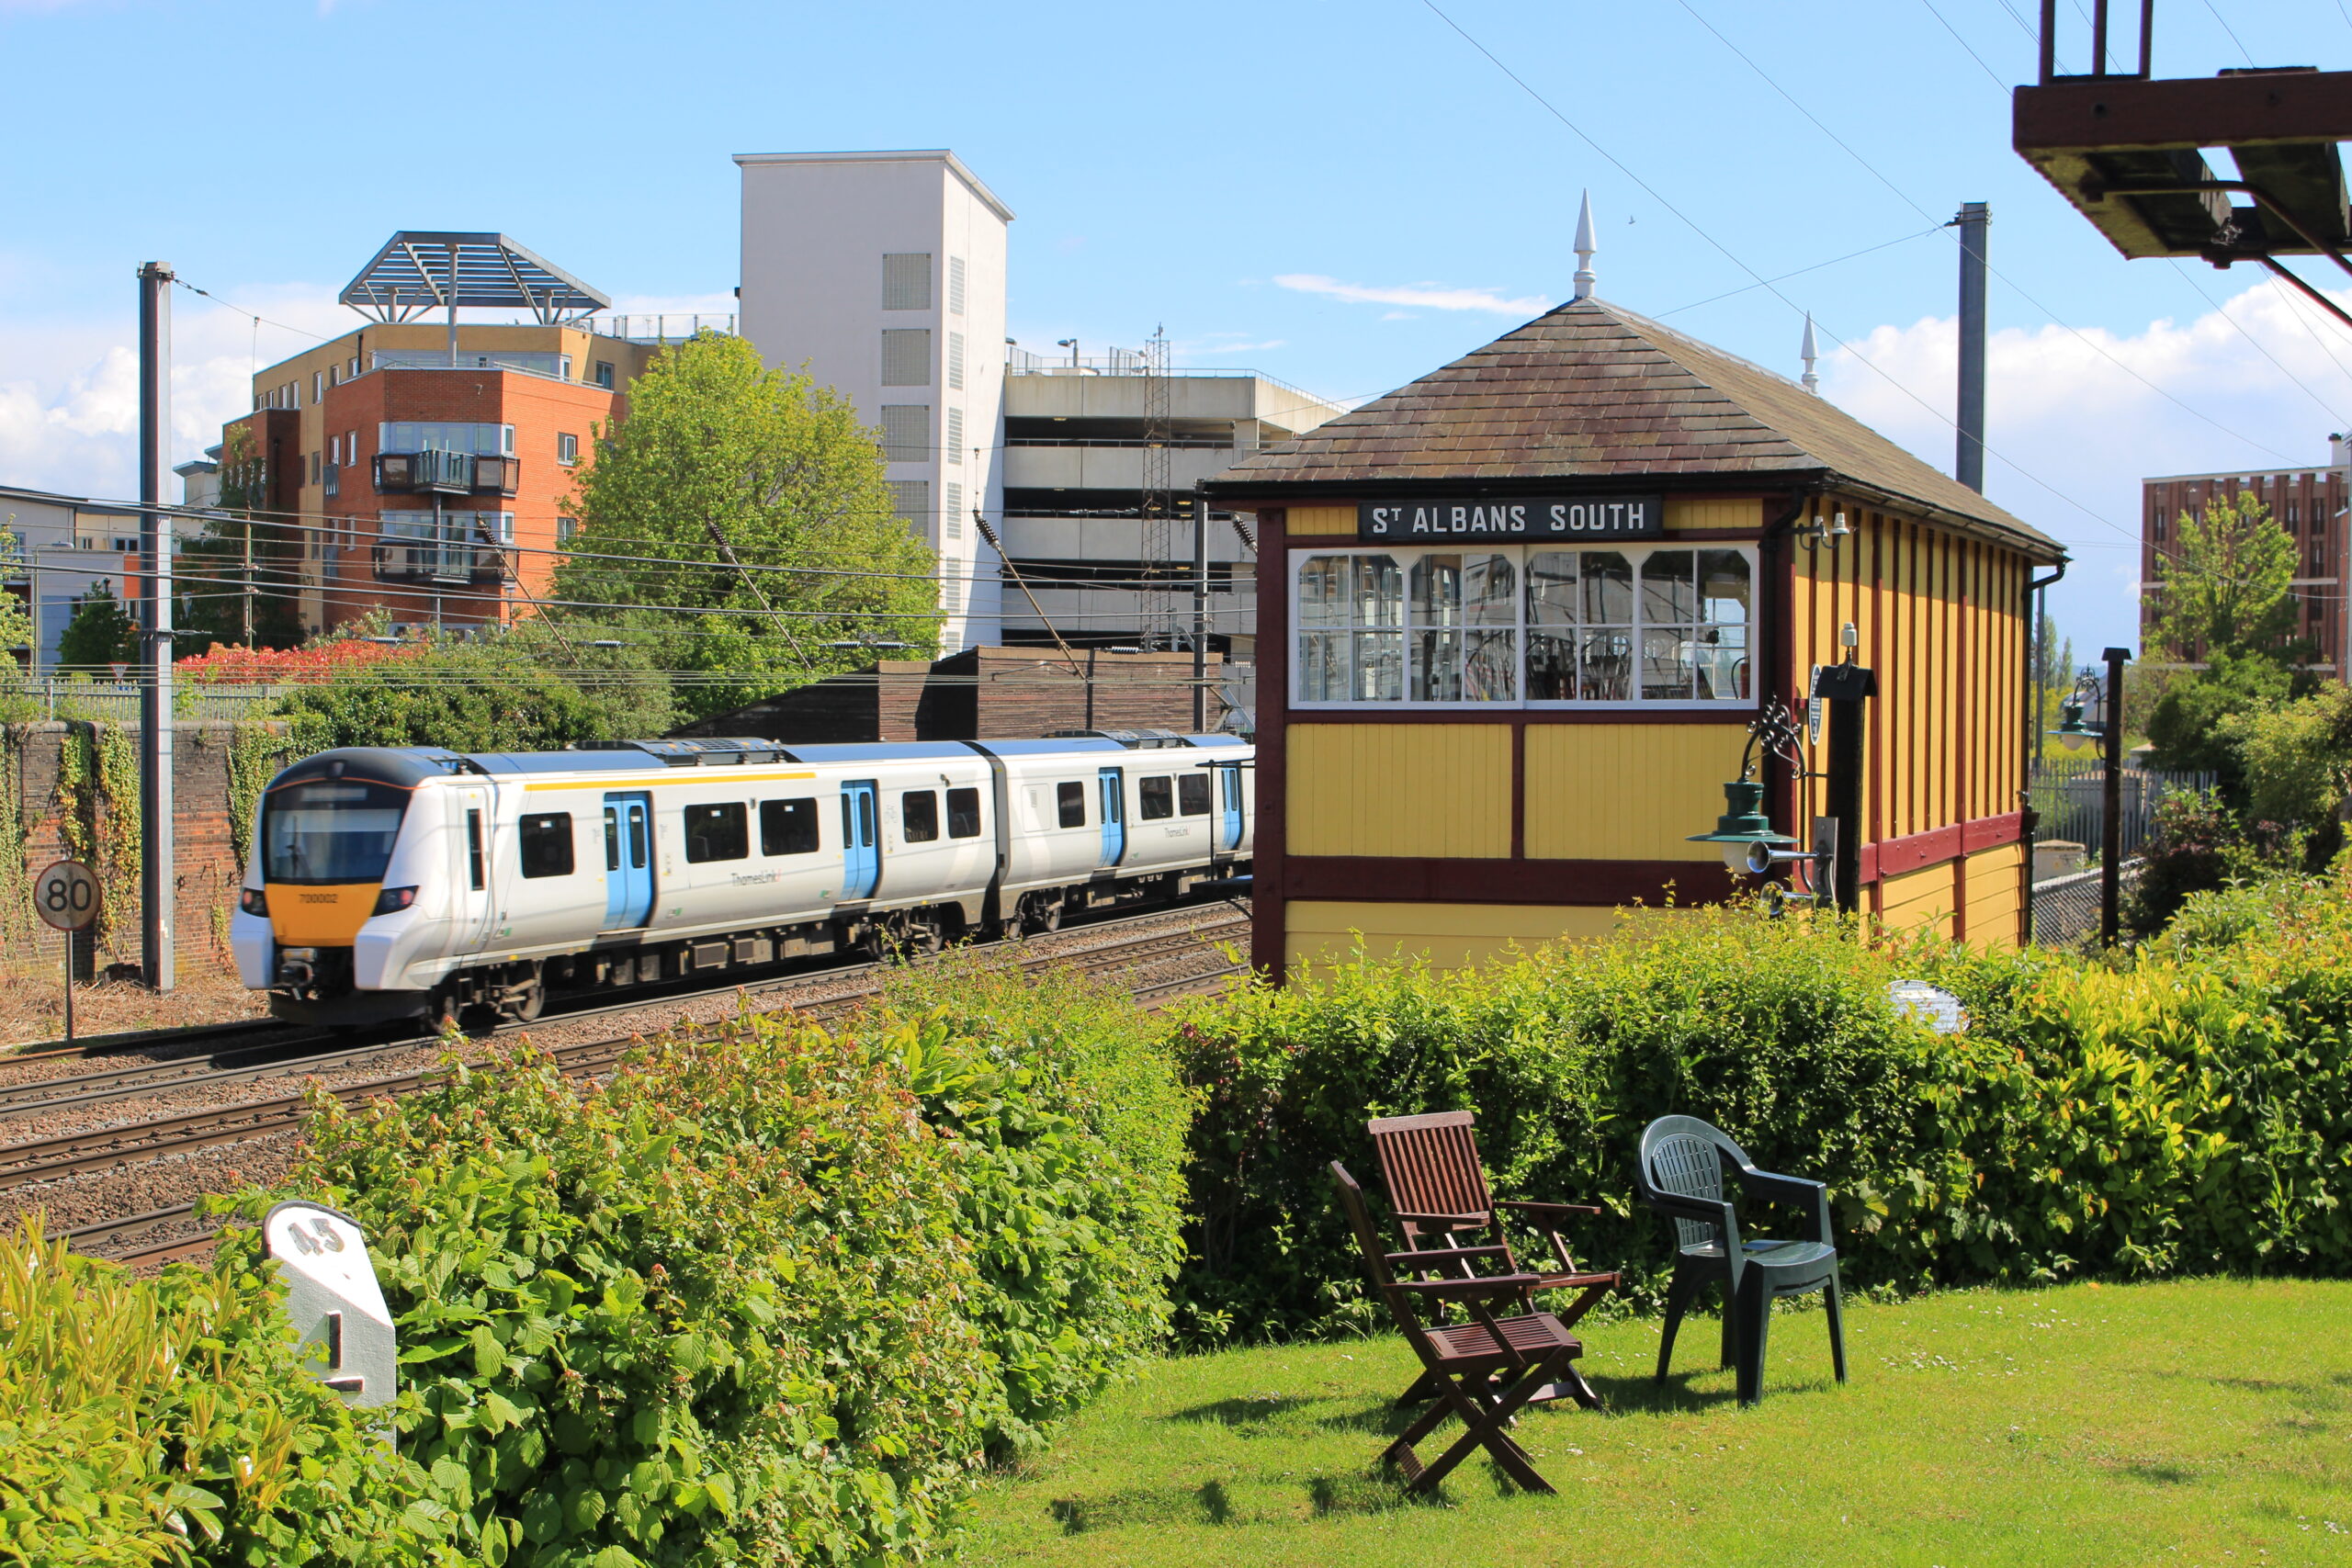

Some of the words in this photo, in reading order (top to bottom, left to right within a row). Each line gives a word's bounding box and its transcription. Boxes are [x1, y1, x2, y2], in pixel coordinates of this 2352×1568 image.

[1412, 505, 1526, 533] ALBANS
[1550, 502, 1645, 531] SOUTH
[47, 878, 92, 912] 80
[288, 1218, 345, 1256] 45
